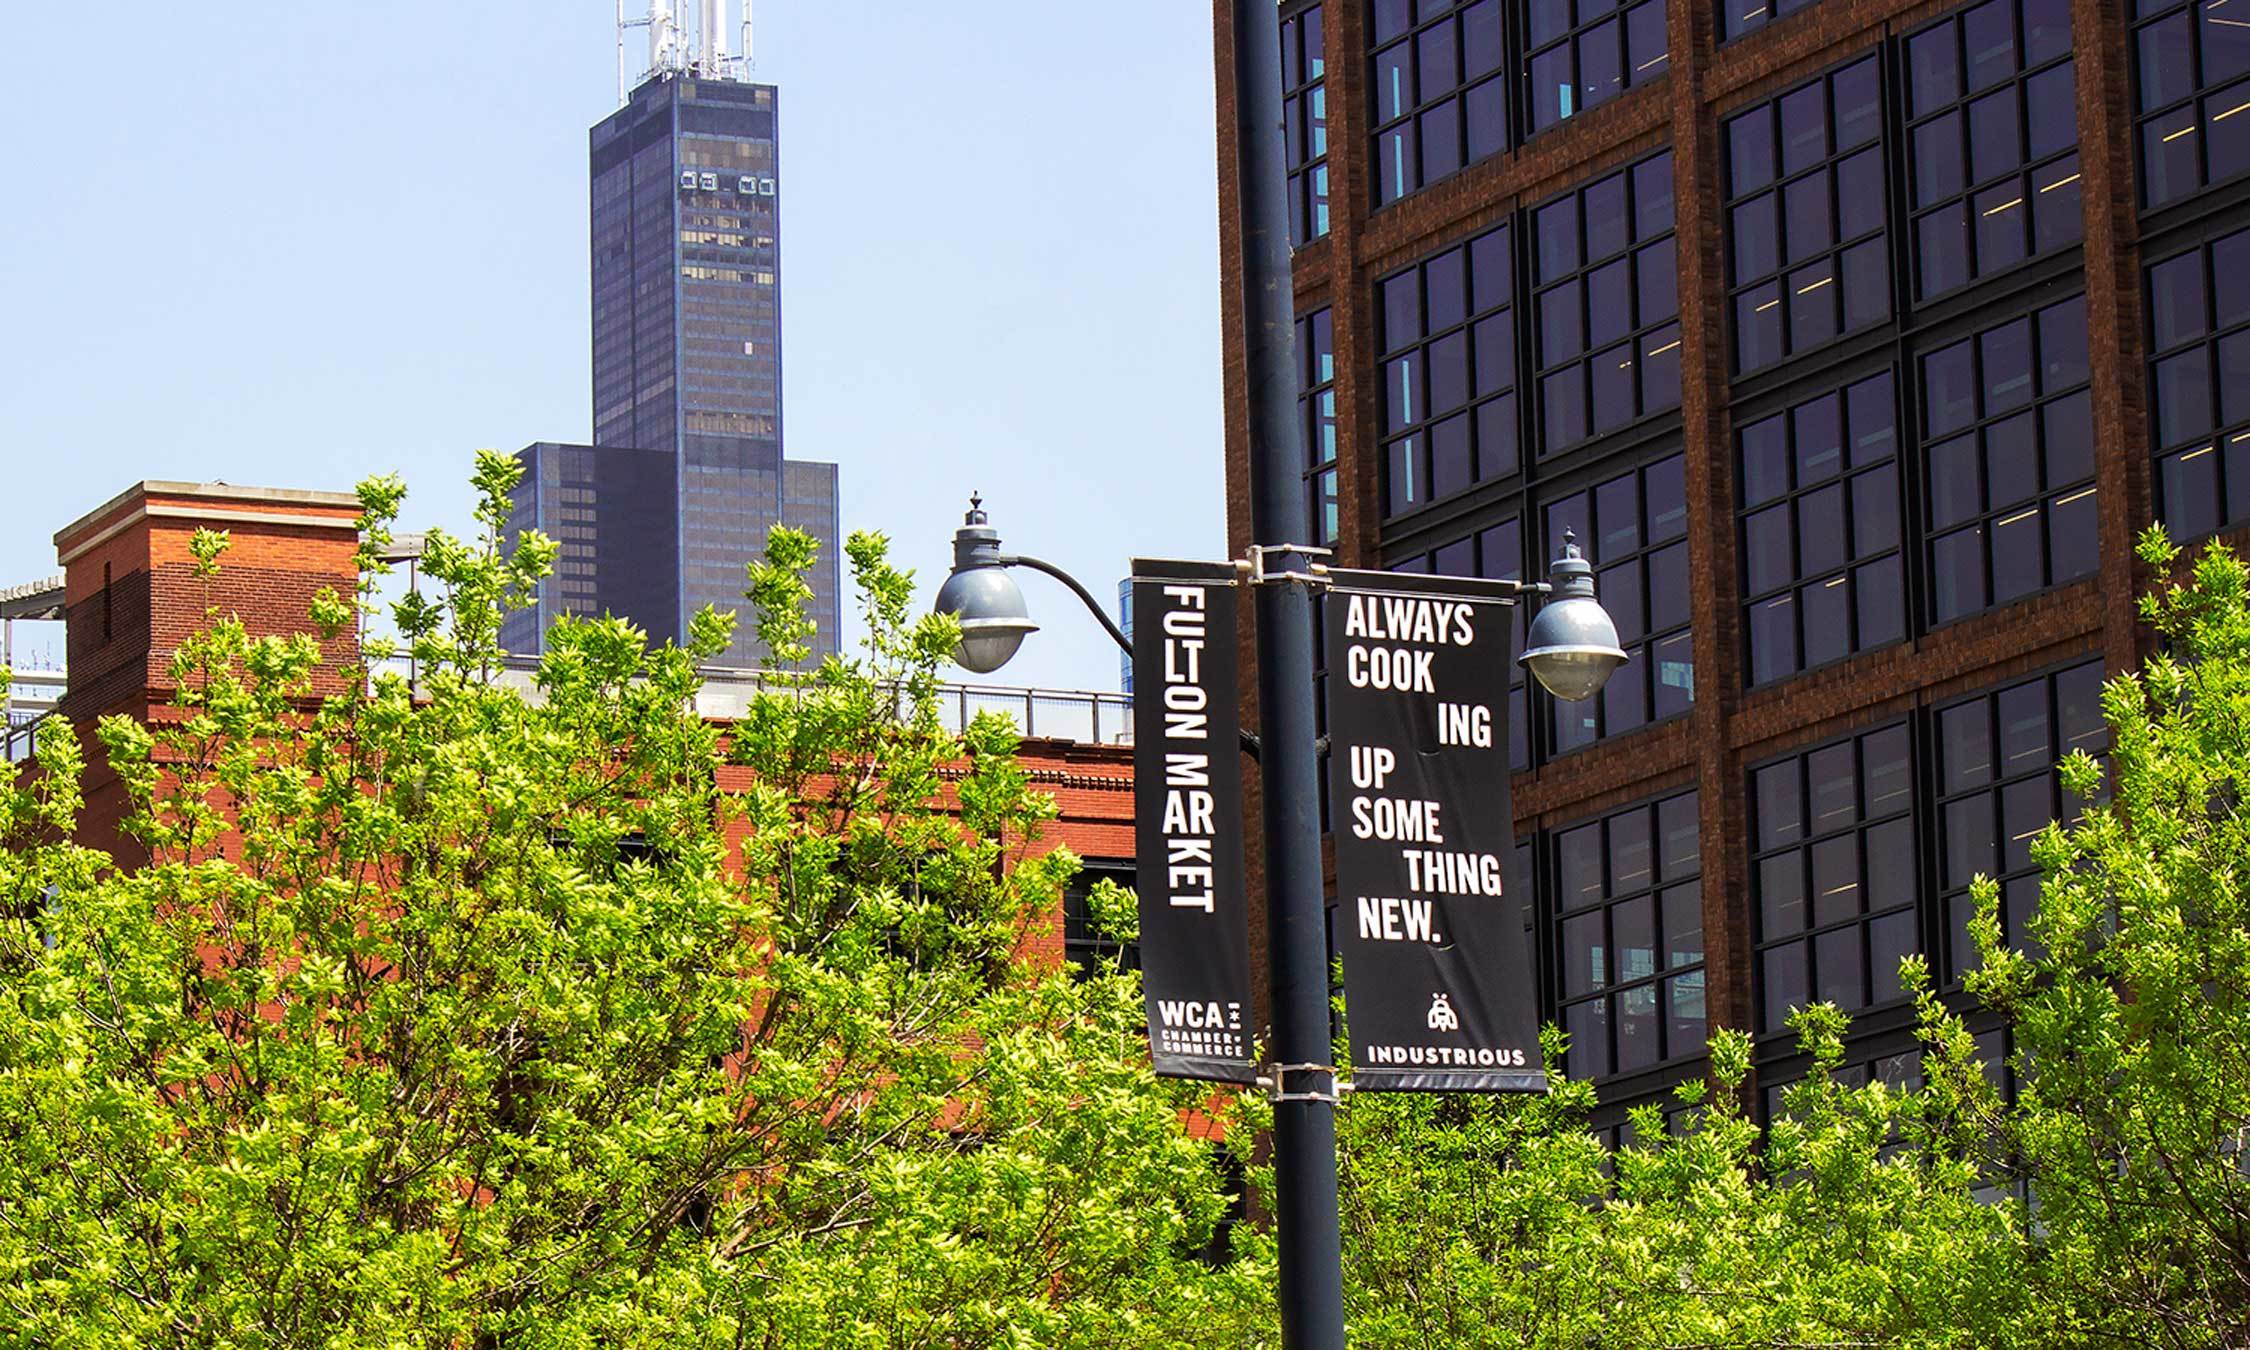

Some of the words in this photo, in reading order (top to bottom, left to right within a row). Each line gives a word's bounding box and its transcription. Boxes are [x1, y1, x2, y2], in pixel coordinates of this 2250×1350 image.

[1345, 595, 1474, 646] ALWAYS
[1164, 586, 1206, 738] FULTON
[1349, 645, 1434, 692] COOK
[1439, 703, 1491, 747] ING
[1351, 746, 1394, 788] UP
[1163, 754, 1215, 912] MARKET
[1352, 797, 1443, 843] SOME
[1403, 850, 1501, 895] THING
[1357, 897, 1441, 943] NEW.
[1158, 1001, 1224, 1028] WCA
[1162, 1029, 1232, 1044] CHAMBER
[1163, 1040, 1243, 1057] COMMERCE
[1367, 1045, 1526, 1067] INDUSTRIOUS
